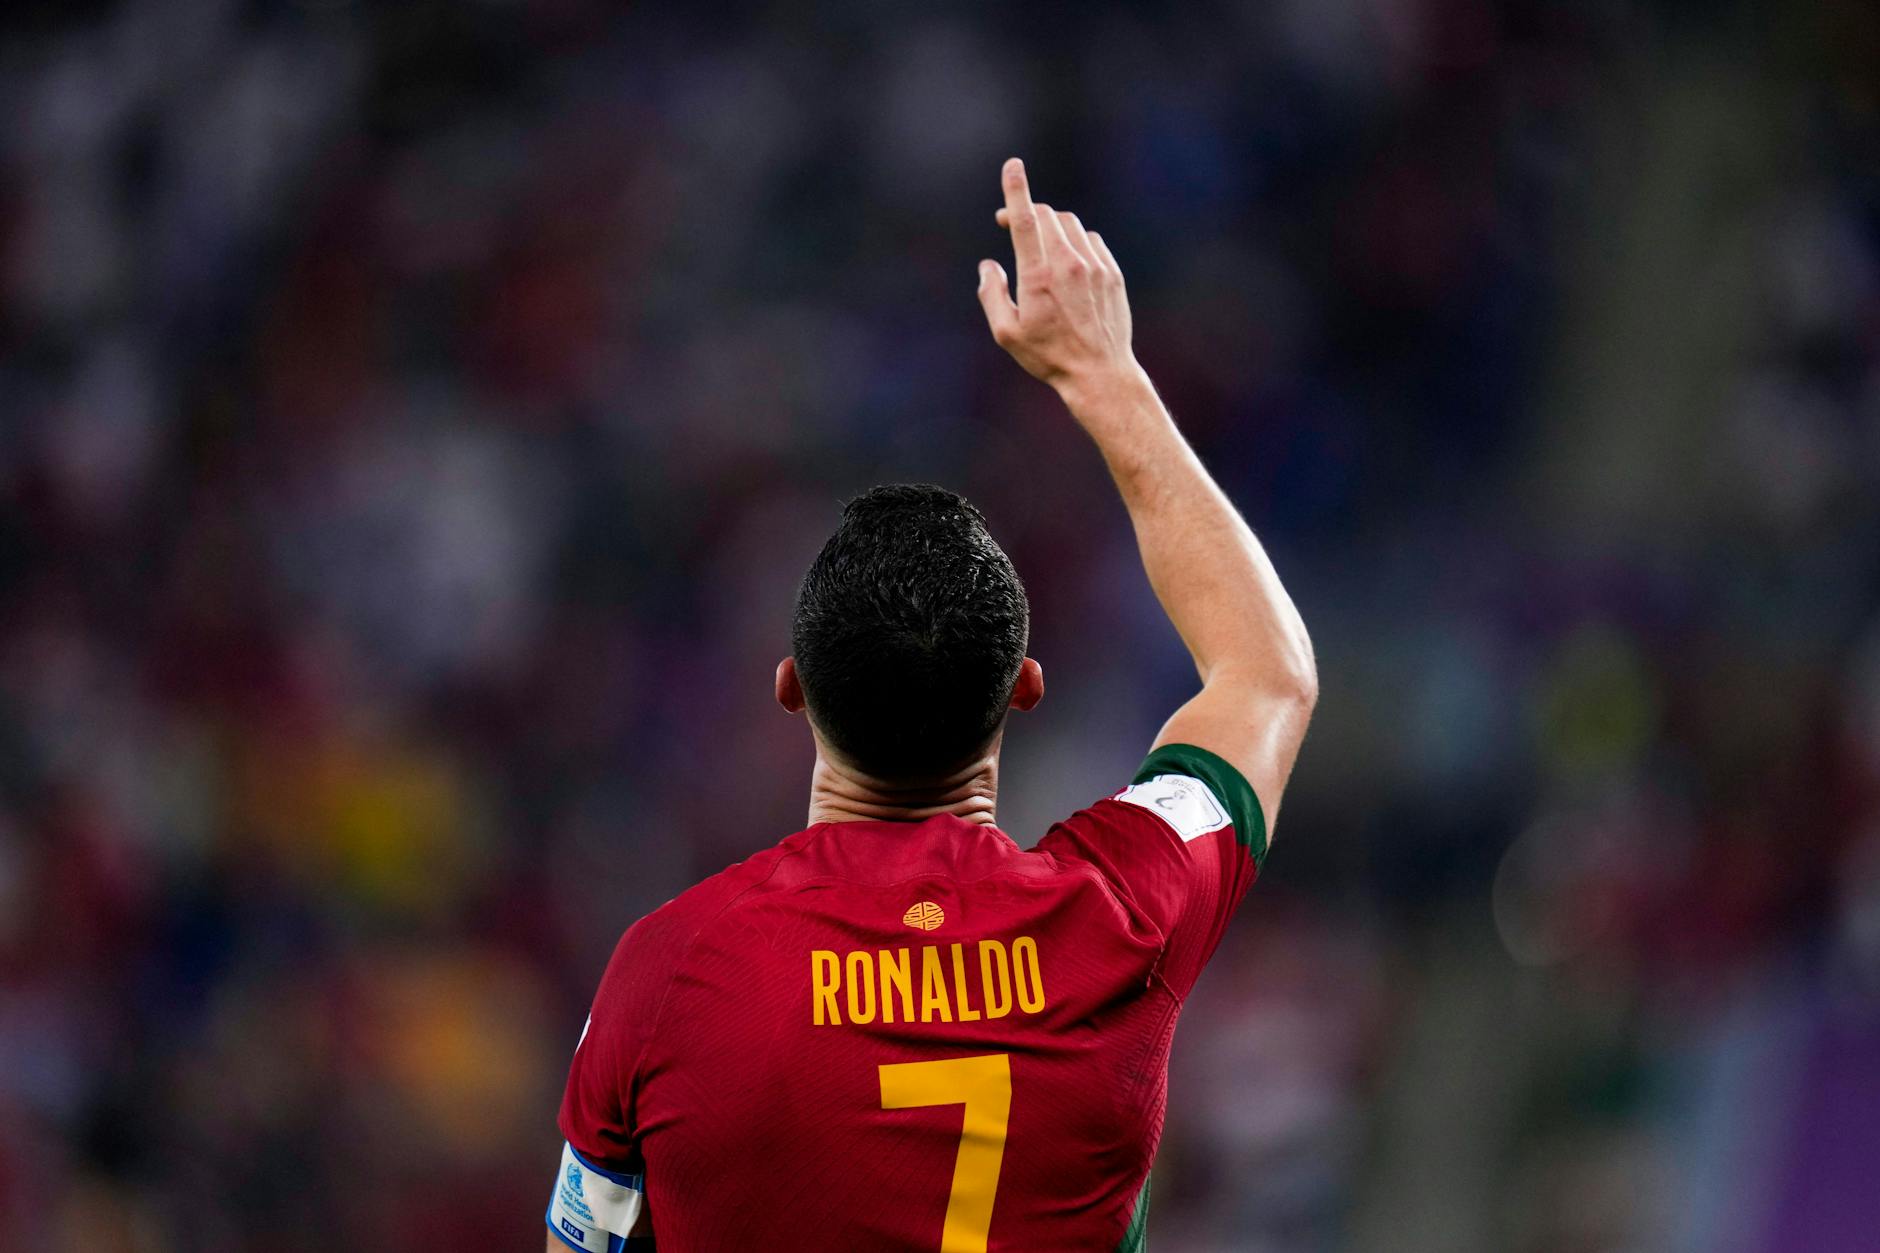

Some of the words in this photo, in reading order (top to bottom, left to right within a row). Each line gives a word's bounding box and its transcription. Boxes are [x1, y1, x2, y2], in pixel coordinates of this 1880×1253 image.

[811, 936, 1045, 1025] RONALDO
[878, 1054, 1012, 1253] 7
[563, 1221, 581, 1239] FIFA
